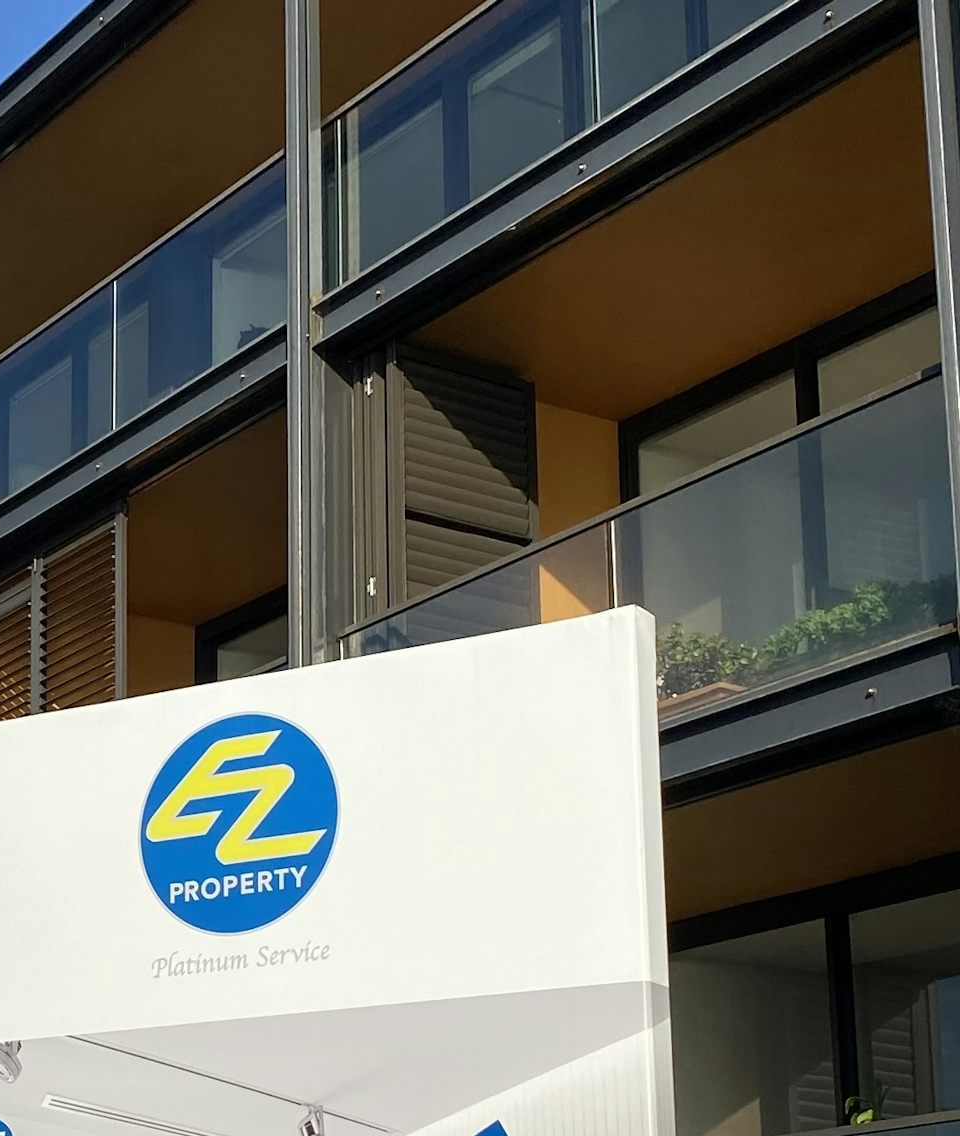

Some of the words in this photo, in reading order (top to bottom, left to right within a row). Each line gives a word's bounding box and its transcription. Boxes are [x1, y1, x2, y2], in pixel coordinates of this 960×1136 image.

[145, 729, 328, 866] EZ
[169, 865, 308, 904] PROPERTY
[151, 951, 248, 979] Platinum
[256, 940, 330, 967] Service
